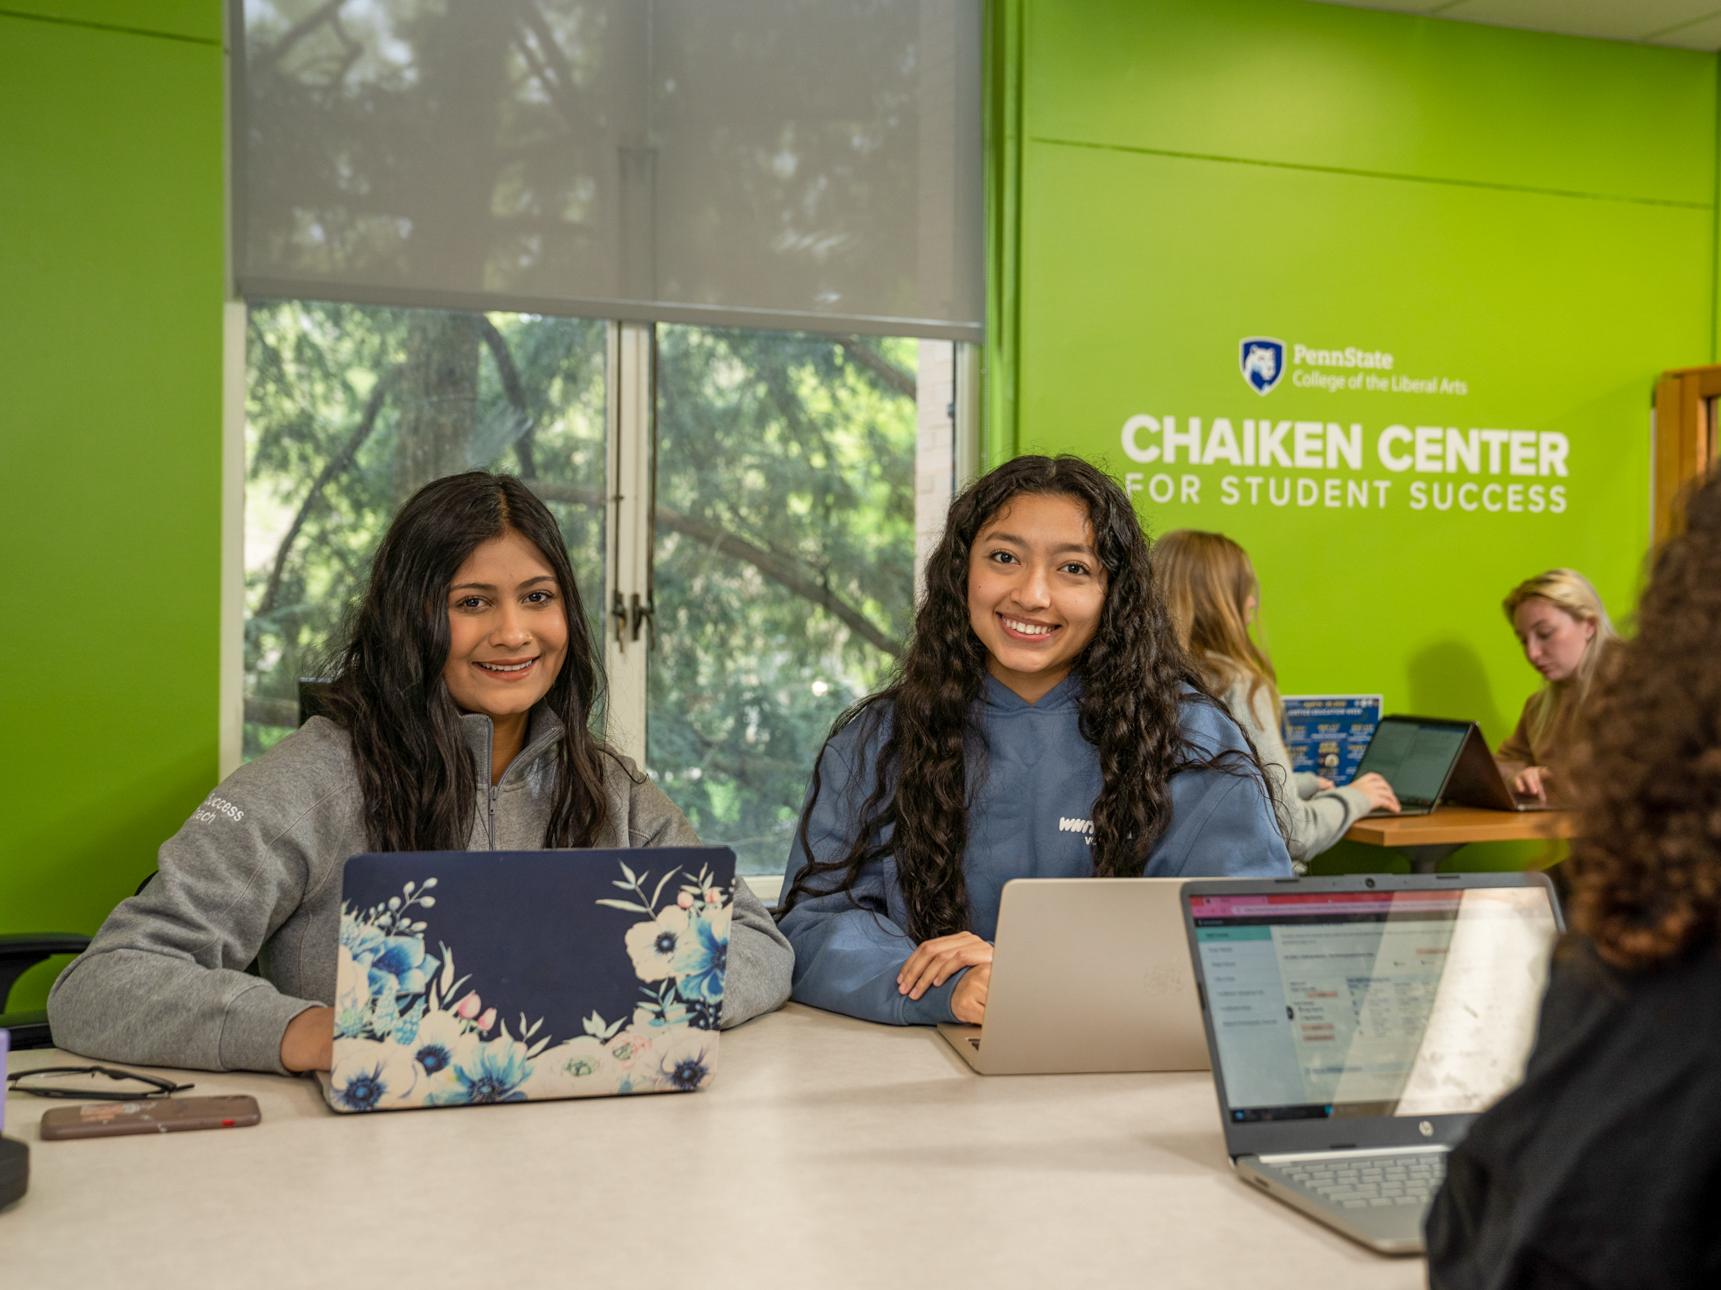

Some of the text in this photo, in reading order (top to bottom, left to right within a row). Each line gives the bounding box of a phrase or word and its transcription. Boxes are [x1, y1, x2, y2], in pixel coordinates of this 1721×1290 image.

[1293, 344, 1393, 369] PennState
[1293, 370, 1468, 395] College of the Liberal Arts
[1120, 414, 1570, 477] CHAIKEN CENTER
[1125, 472, 1568, 513] FOR STUDENT SUCCESS
